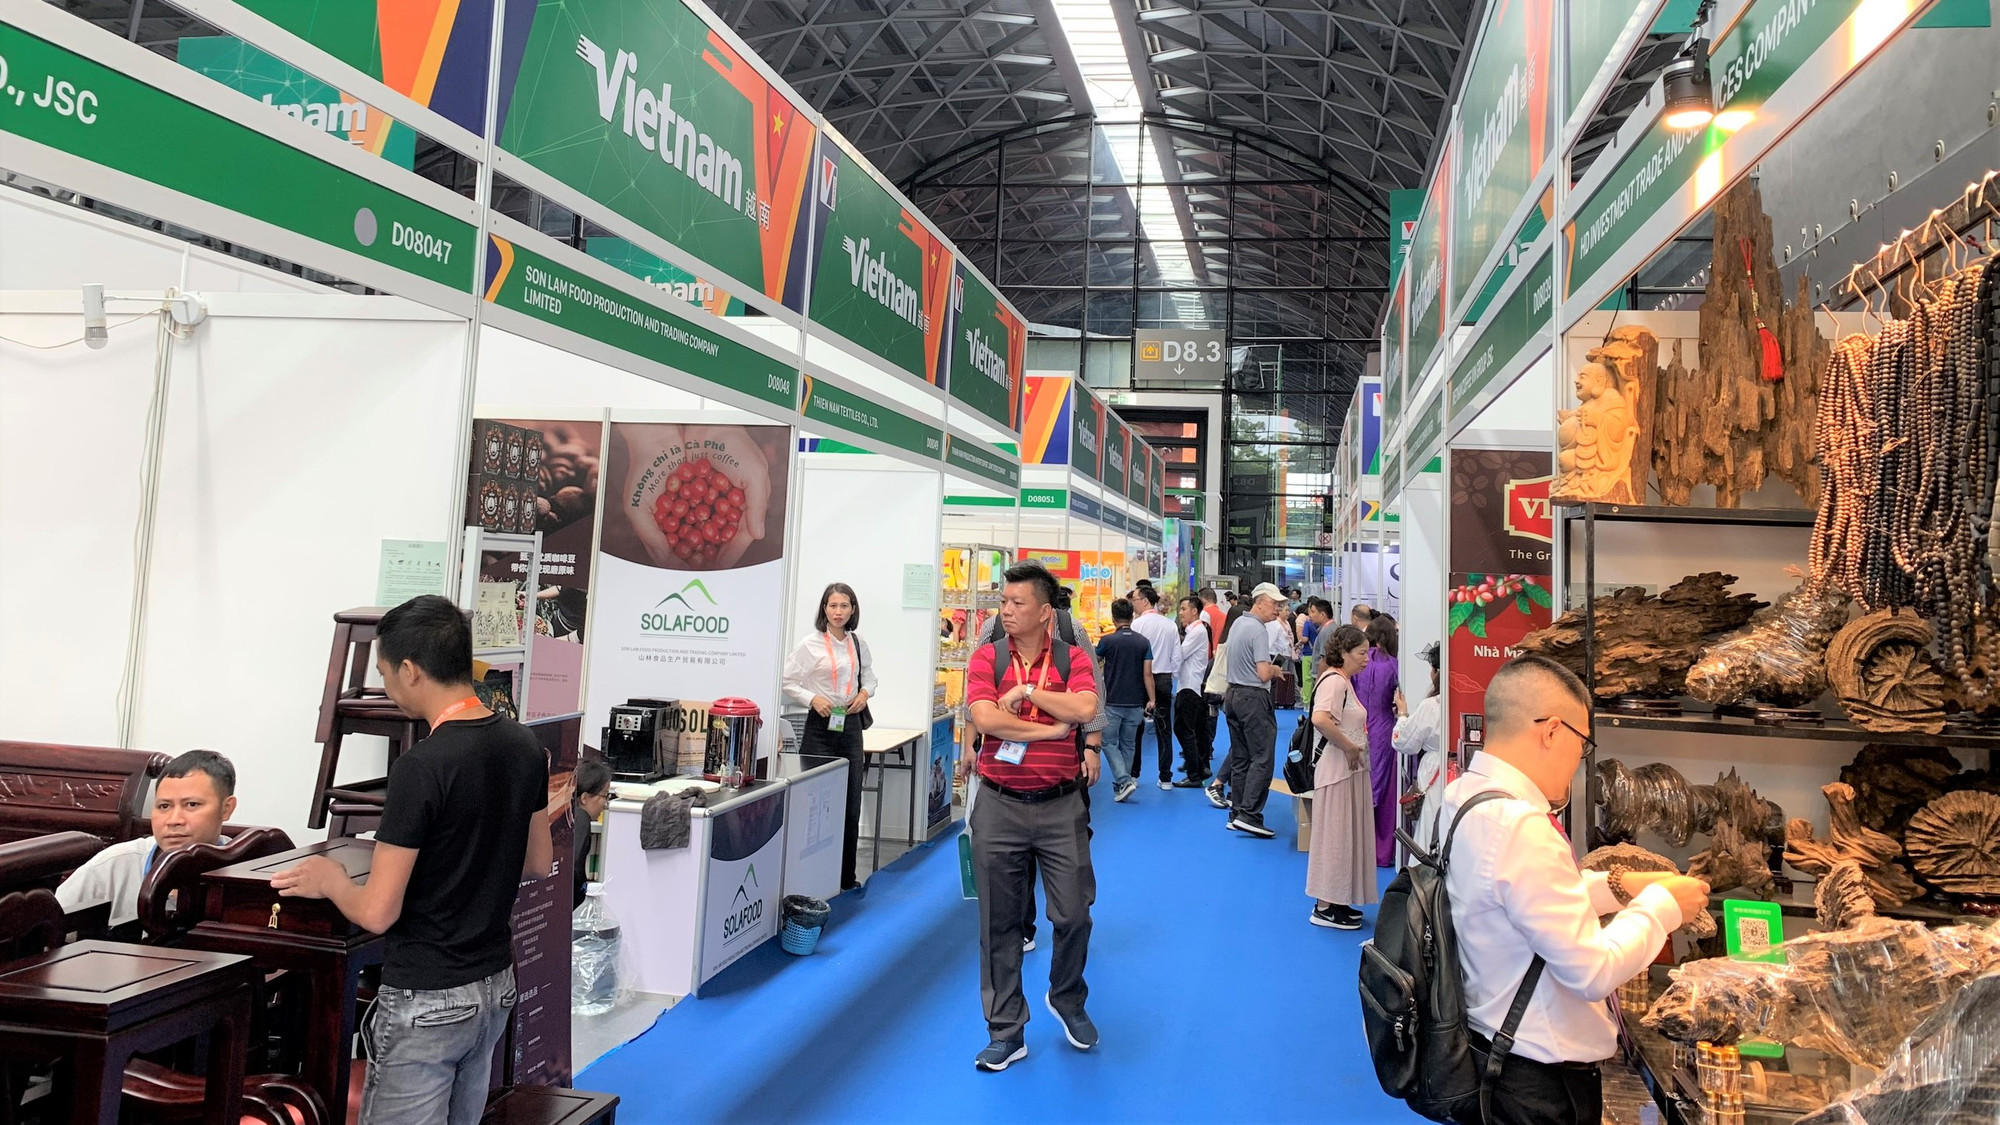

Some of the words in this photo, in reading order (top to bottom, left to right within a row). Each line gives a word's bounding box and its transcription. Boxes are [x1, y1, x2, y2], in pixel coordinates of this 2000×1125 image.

[33, 74, 98, 125] JSC
[575, 33, 743, 213] Vietnam
[1464, 62, 1519, 221] Vietnam
[1580, 231, 1590, 260] HD
[1590, 178, 1636, 250] INVESTMENT
[1636, 146, 1664, 200] TRADE
[1664, 127, 1686, 170] AND
[1745, 0, 1816, 80] COMPAN
[744, 188, 771, 232] 越南
[391, 221, 453, 265] D08047
[524, 286, 562, 315] LIMITED
[842, 235, 918, 327] Vietnam
[525, 265, 547, 288] SON
[547, 274, 568, 297] LAM
[568, 284, 593, 306] FOOD
[593, 294, 644, 328] PRODUCTION
[644, 315, 660, 334] AND
[660, 322, 690, 346] TRADING
[689, 334, 720, 357] COMPANY
[965, 327, 1006, 388] Vietnam
[1162, 340, 1222, 363] D8.3
[768, 373, 791, 395] D08048
[813, 395, 829, 411] THIEN
[840, 405, 861, 423] TEXTILES
[869, 416, 879, 429] LTD.
[631, 468, 654, 508] Không
[670, 445, 682, 456] là
[684, 440, 700, 450] Cà
[704, 440, 726, 452] Phê
[648, 470, 667, 494] More
[668, 456, 688, 471] than
[691, 452, 708, 462] just
[712, 452, 740, 468] coffee
[1027, 494, 1055, 504] D08051
[1509, 549, 1533, 560] The
[1536, 550, 1553, 561] Gr
[640, 613, 730, 634] SOLAFOOD
[1474, 645, 1500, 658] Nhà
[723, 898, 763, 939] SOLAFOOD
